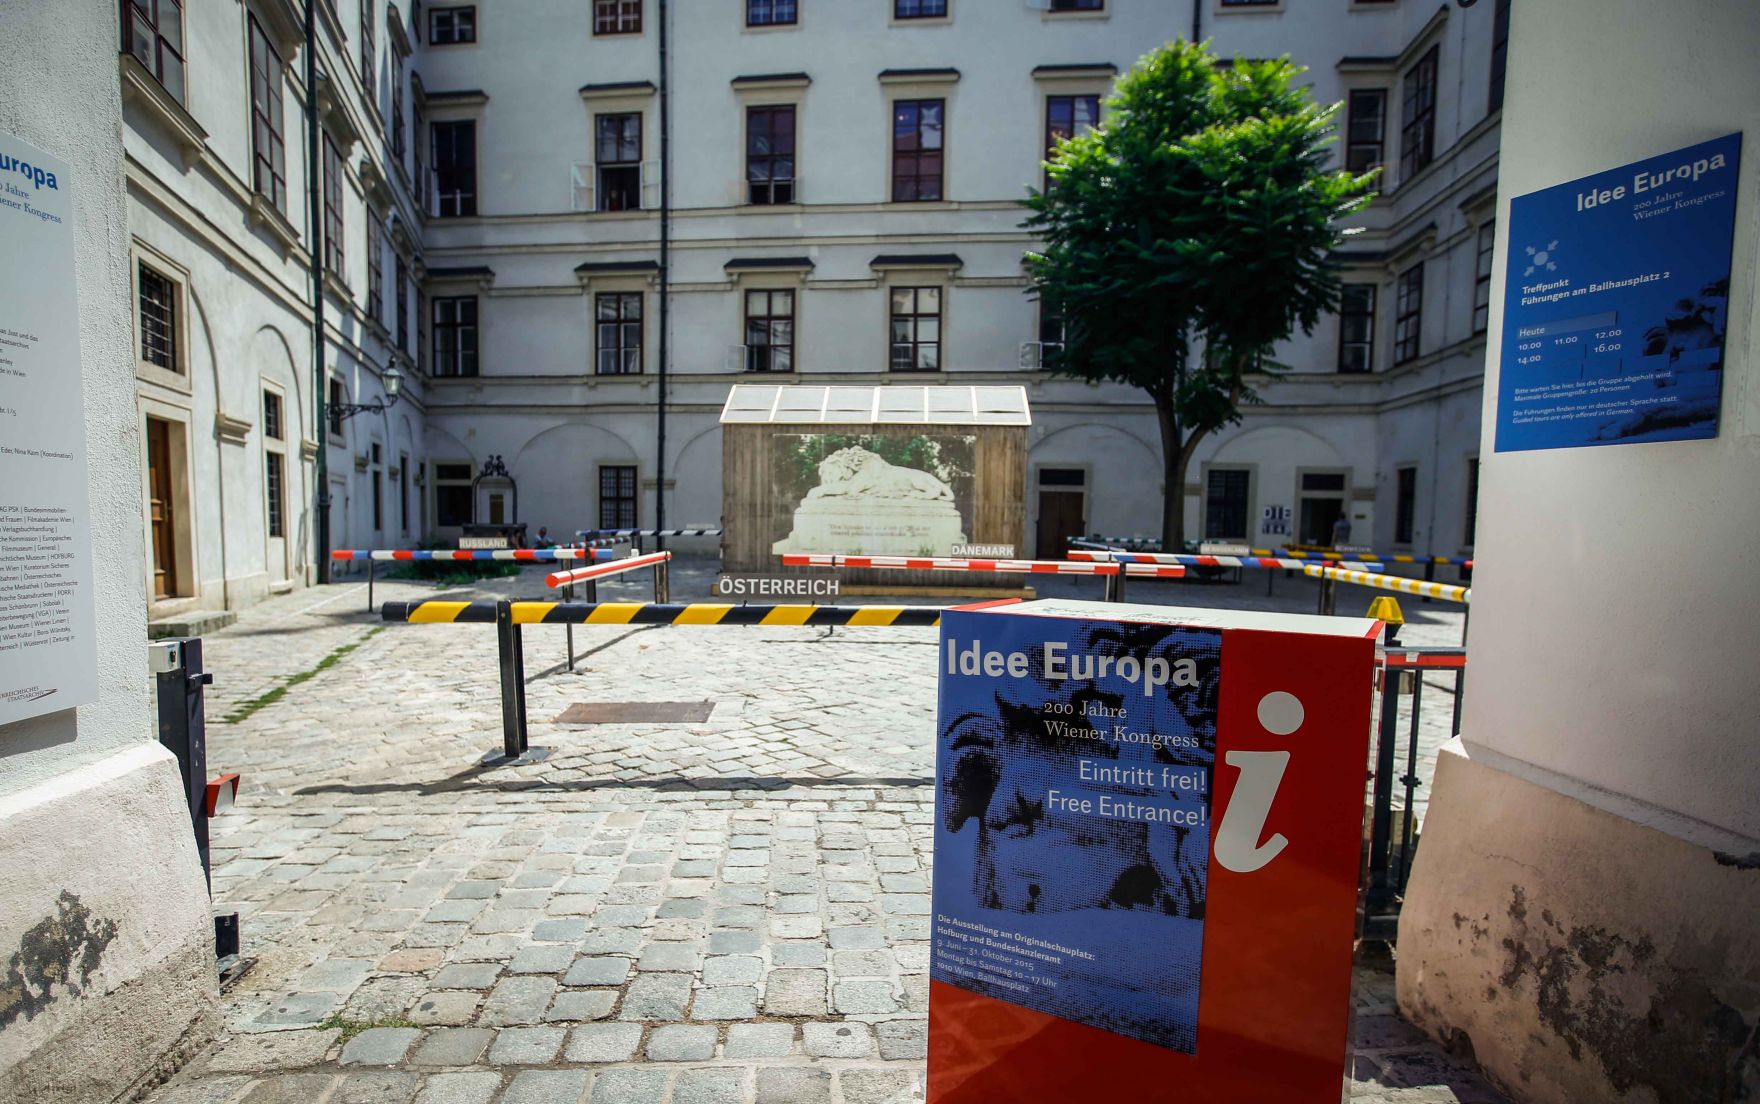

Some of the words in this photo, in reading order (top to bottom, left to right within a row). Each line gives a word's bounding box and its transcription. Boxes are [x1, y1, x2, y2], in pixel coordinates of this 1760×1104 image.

[5, 183, 30, 199] Jahre
[1577, 185, 1625, 211] Idee
[1633, 153, 1726, 194] Europa
[1633, 201, 1651, 211] 200
[1654, 191, 1684, 205] Jahre
[1633, 205, 1671, 221] Wiener
[1674, 190, 1726, 210] Kongress
[23, 202, 62, 223] Kongress
[1521, 291, 1570, 306] Führungen
[1572, 288, 1587, 296] am
[1589, 273, 1660, 293] Ballhausplatz
[1663, 271, 1670, 279] 2
[1522, 279, 1569, 295] Treffpunkt
[1518, 342, 1542, 351] 10.00
[1554, 336, 1578, 345] 11.00
[1595, 329, 1622, 339] 12.00
[1519, 327, 1545, 337] Heute
[1517, 355, 1541, 365] 14.00
[1594, 343, 1621, 353] 16.00
[1598, 378, 1623, 386] Gruppe
[1624, 373, 1654, 382] abgeholt
[1596, 401, 1629, 409] deutscher
[1630, 397, 1659, 406] Sprache
[460, 539, 507, 549] RUSSLAND
[952, 542, 1015, 556] DÄNEMARK
[719, 575, 840, 595] ÖSTERREICH
[947, 639, 1029, 678] Idee
[1044, 641, 1200, 696] Europa
[7, 690, 45, 702] STAATSARCHIV
[1044, 702, 1073, 714] 200
[1079, 700, 1127, 719] Jahre
[1044, 720, 1107, 741] Wiener
[1114, 726, 1199, 750] Kongress
[1079, 760, 1155, 787] Eintritt
[1161, 767, 1206, 791] frei!
[1048, 791, 1092, 813] Free
[1100, 796, 1206, 826] Entrance!
[937, 914, 951, 924] Die
[952, 917, 999, 937] Ausstellung
[1000, 931, 1013, 939] am
[1014, 932, 1096, 961] Originalschauplatz:
[937, 926, 968, 942] Hofburg
[969, 934, 984, 944] und
[986, 938, 1061, 964] Bundeskanzleramt
[946, 940, 961, 950] Juni
[982, 948, 1013, 963] Oktober
[1014, 960, 1034, 971] 2015
[937, 949, 964, 964] Montag
[966, 956, 977, 966] bis
[979, 961, 1012, 977] Samstag
[1031, 976, 1040, 985] 17
[1042, 978, 1058, 988] Uhr
[937, 962, 952, 972] 1010
[954, 965, 976, 979] Wien,
[977, 972, 1030, 993] Ballhausplatz
